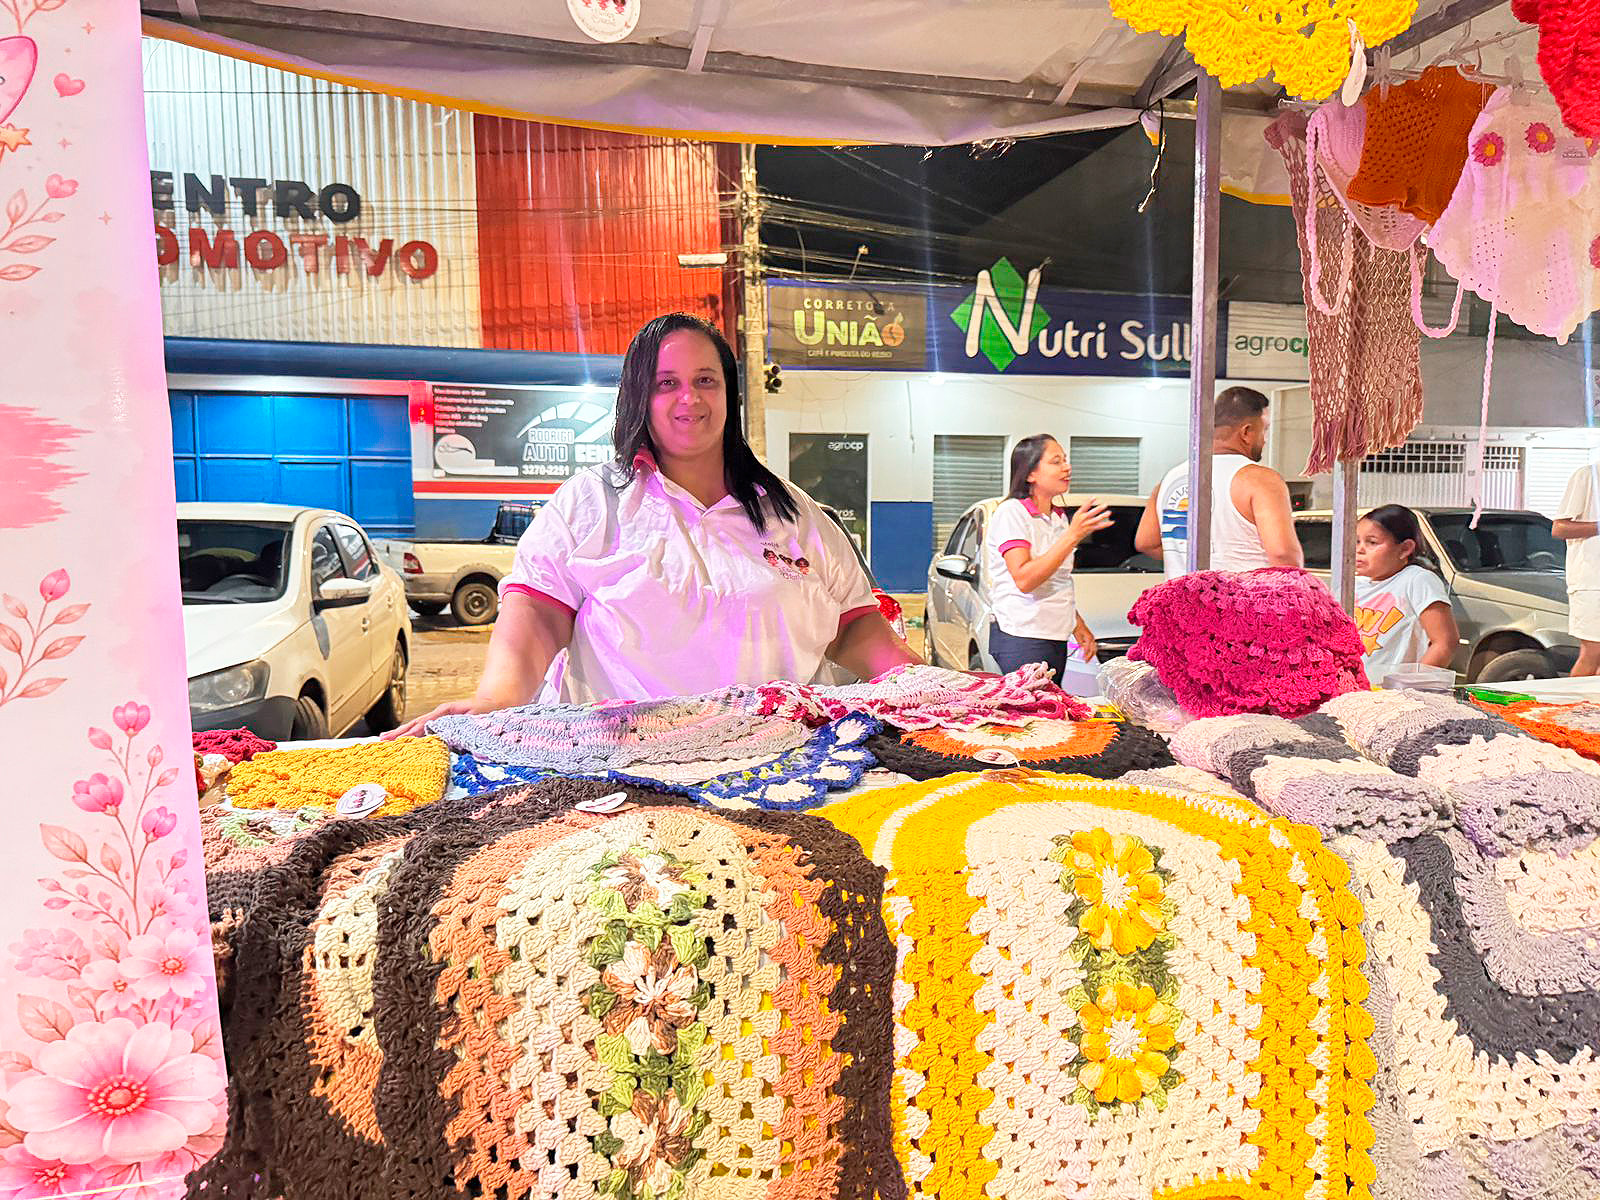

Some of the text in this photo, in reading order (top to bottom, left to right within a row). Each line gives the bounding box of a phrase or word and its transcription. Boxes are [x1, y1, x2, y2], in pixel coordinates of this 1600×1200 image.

[150, 171, 361, 223] ENTRO
[803, 298, 895, 312] CORRETOA
[523, 443, 568, 462] AUTO
